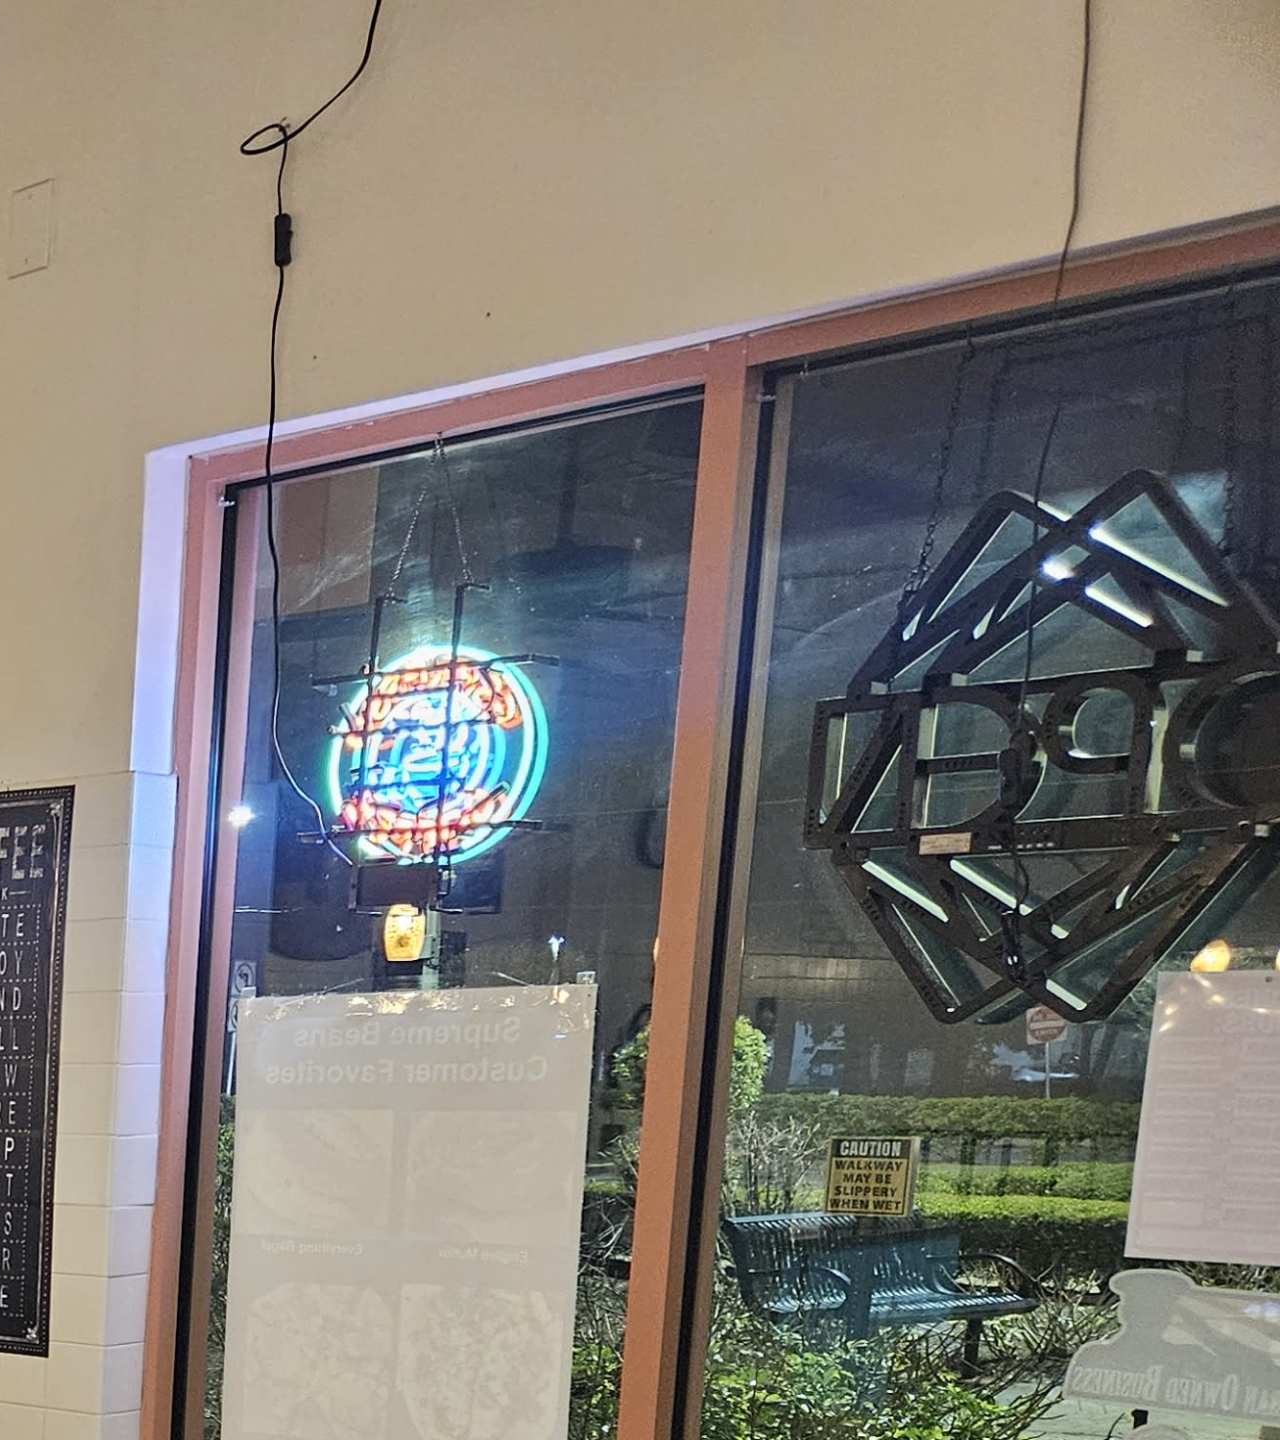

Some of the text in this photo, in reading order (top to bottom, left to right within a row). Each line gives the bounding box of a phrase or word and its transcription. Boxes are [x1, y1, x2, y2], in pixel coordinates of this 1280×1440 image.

[840, 1141, 901, 1157] CAUTION
[834, 1160, 903, 1172] WALKWAY
[843, 1173, 892, 1184] MAY BE
[834, 1185, 897, 1198] SLIPPERY
[829, 1199, 902, 1211] WHEN WET
